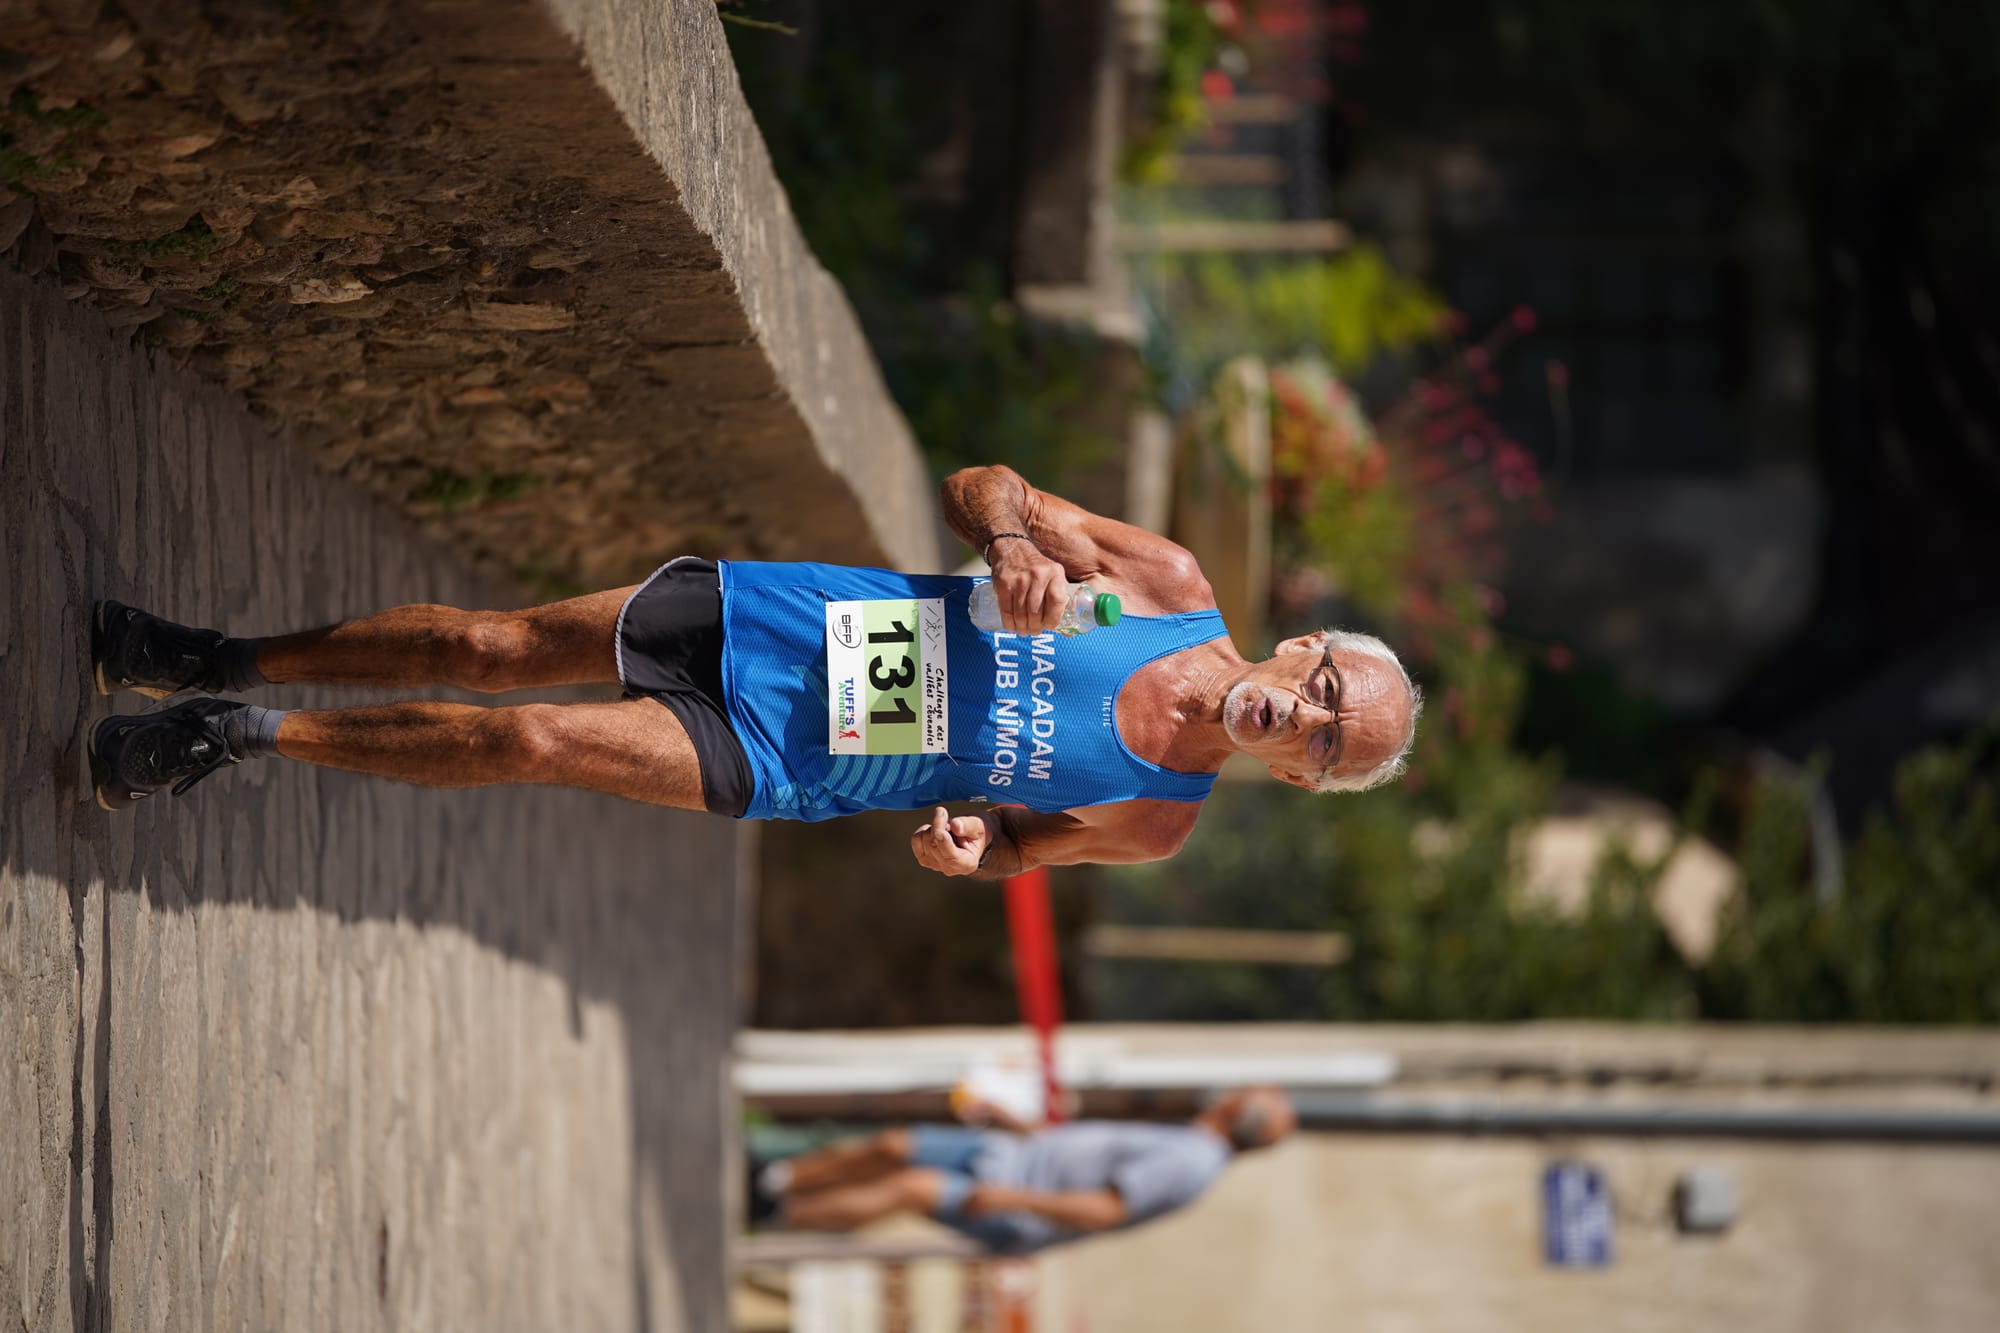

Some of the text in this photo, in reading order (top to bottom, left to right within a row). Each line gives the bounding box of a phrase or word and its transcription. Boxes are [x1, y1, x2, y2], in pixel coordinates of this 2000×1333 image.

[841, 614, 852, 644] BFP
[838, 682, 847, 730] Aventure
[845, 677, 855, 725] TUFF'S
[868, 621, 916, 724] 131
[926, 663, 934, 747] vallées cévenoles
[934, 667, 945, 742] Challenge des
[988, 632, 1024, 787] LUB NÎMOIS
[1028, 633, 1055, 780] MACADAM
